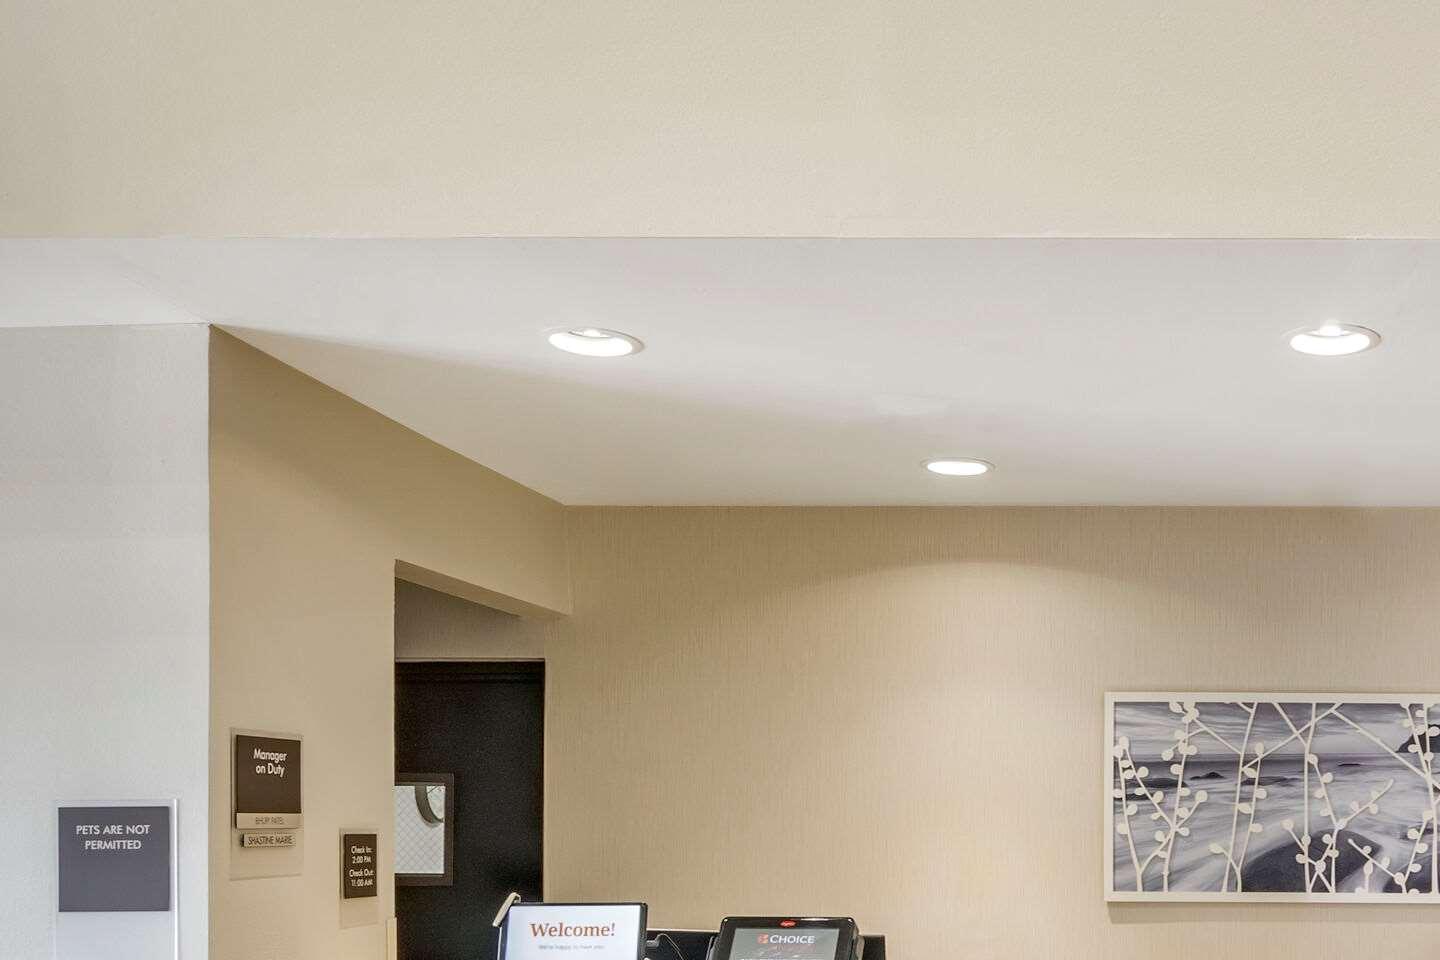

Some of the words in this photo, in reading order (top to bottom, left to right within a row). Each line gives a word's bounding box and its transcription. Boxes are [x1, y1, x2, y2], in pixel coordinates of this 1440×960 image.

[253, 748, 287, 763] Manager
[255, 764, 266, 774] on
[267, 763, 285, 777] Duty
[76, 824, 100, 835] PETS
[103, 824, 123, 835] ARE
[126, 824, 151, 834] NOT
[84, 839, 142, 850] PERMITTED
[351, 845, 365, 854] Check
[364, 855, 371, 863] PM
[349, 868, 363, 877] Check
[529, 922, 616, 937] Welcome!
[769, 934, 816, 944] CHOICE
